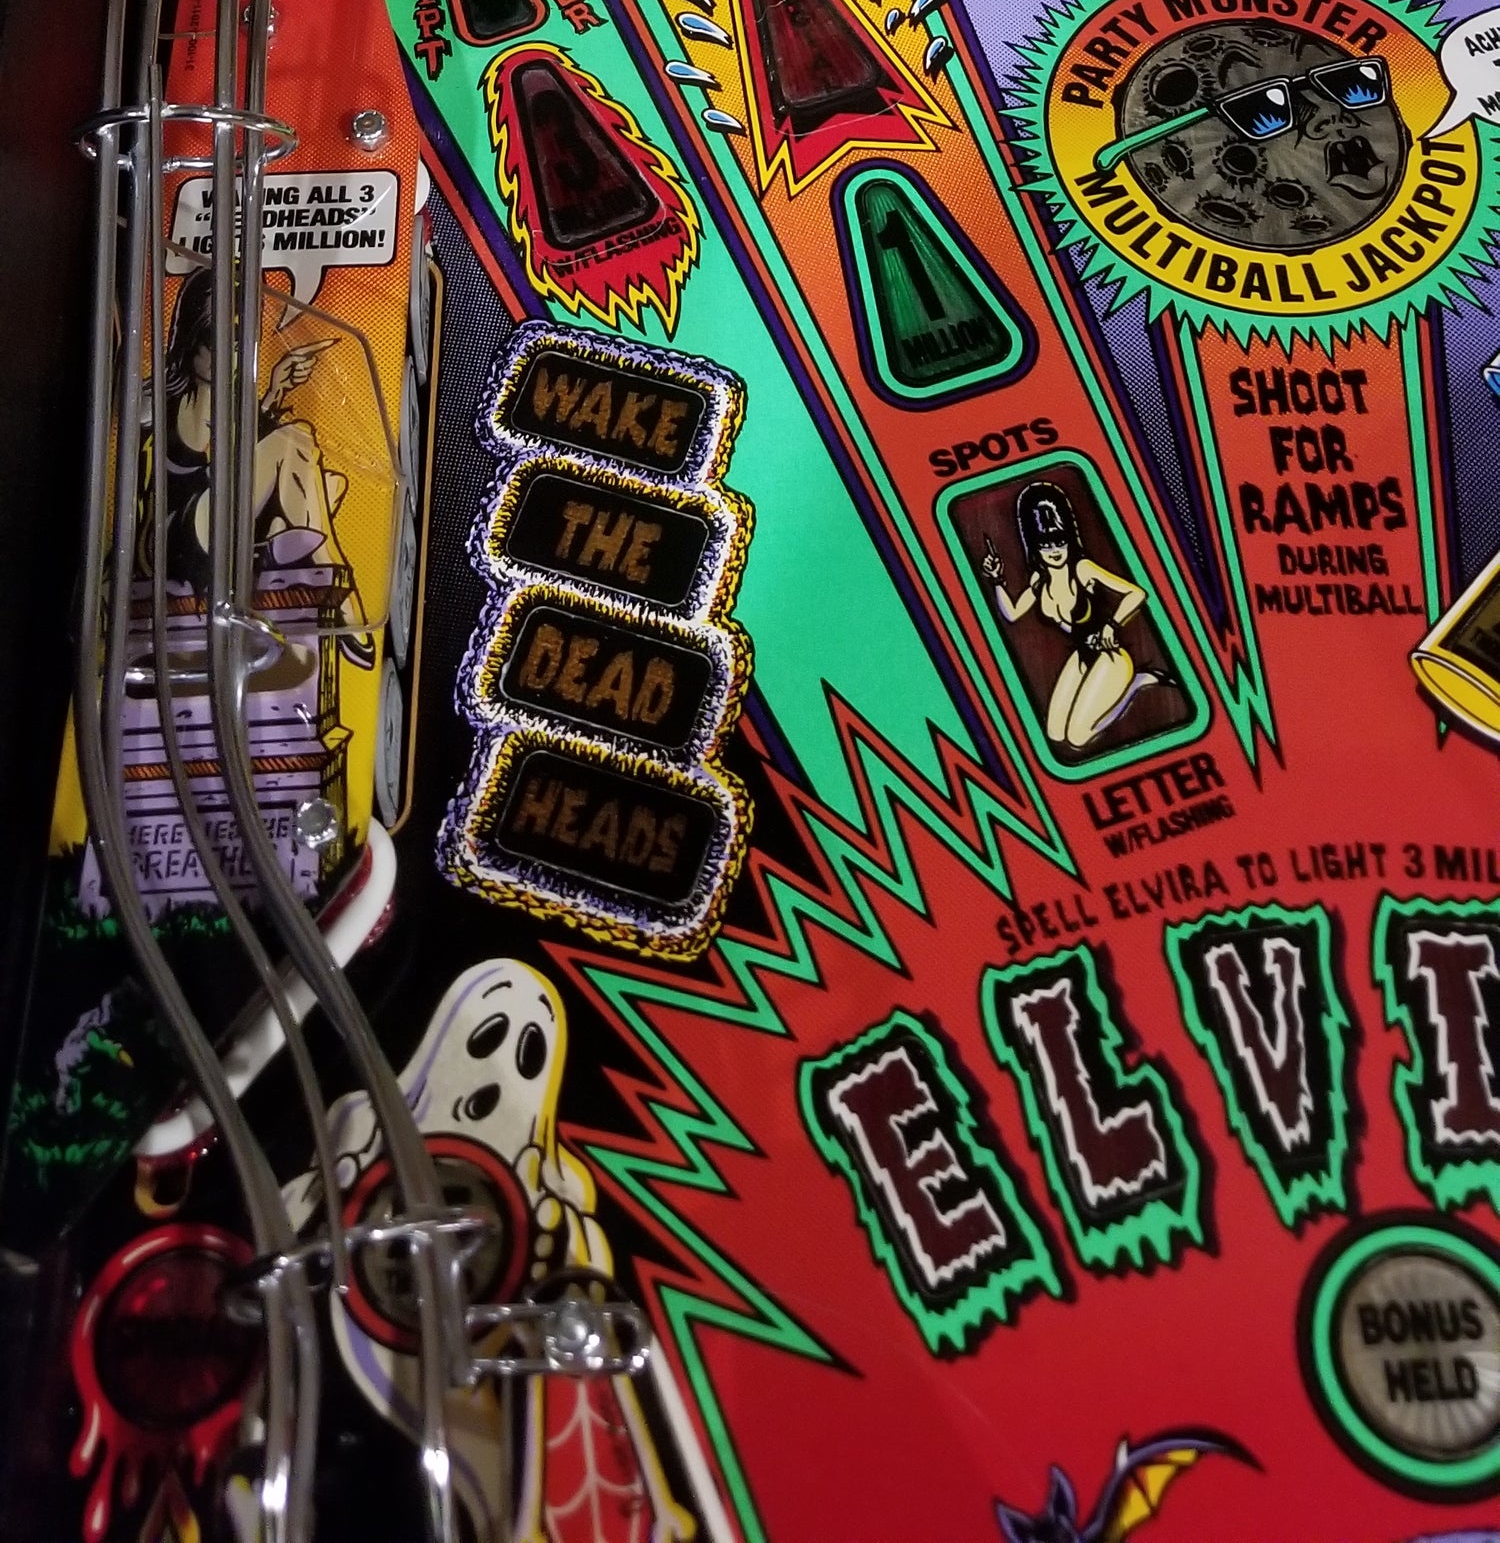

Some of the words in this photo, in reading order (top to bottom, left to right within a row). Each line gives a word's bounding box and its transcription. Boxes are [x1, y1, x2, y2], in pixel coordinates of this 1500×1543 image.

[1062, 0, 1160, 109] PARTY
[1464, 27, 1500, 57] ACH
[306, 185, 352, 205] ALL
[359, 185, 375, 203] 3
[1073, 167, 1338, 304] MULTIBALL
[1345, 137, 1468, 294] JACKPOT
[273, 229, 386, 251] MILLION!
[878, 210, 946, 321] 1
[901, 316, 994, 368] MILLION
[532, 370, 689, 456] WAKE
[1229, 366, 1369, 417] SHOOT
[929, 417, 1059, 478] SPOTS
[1269, 423, 1355, 476] FOR
[1238, 476, 1409, 535] RAMPS
[555, 499, 663, 584] THE
[1277, 543, 1390, 576] DURING
[1255, 583, 1425, 615] MULTIBALL
[518, 623, 676, 727] DEAD
[1082, 752, 1225, 831] LETTER
[512, 771, 688, 875] HEADS
[1104, 794, 1236, 858] W/FLASHING
[996, 893, 1099, 955] SPELL
[1103, 863, 1230, 921] ELVIRA
[1237, 853, 1279, 889] TO
[1289, 842, 1387, 883] LIGHT
[1404, 842, 1426, 879] 3
[1358, 1298, 1485, 1346] BONUS
[1384, 1356, 1479, 1403] HELD
